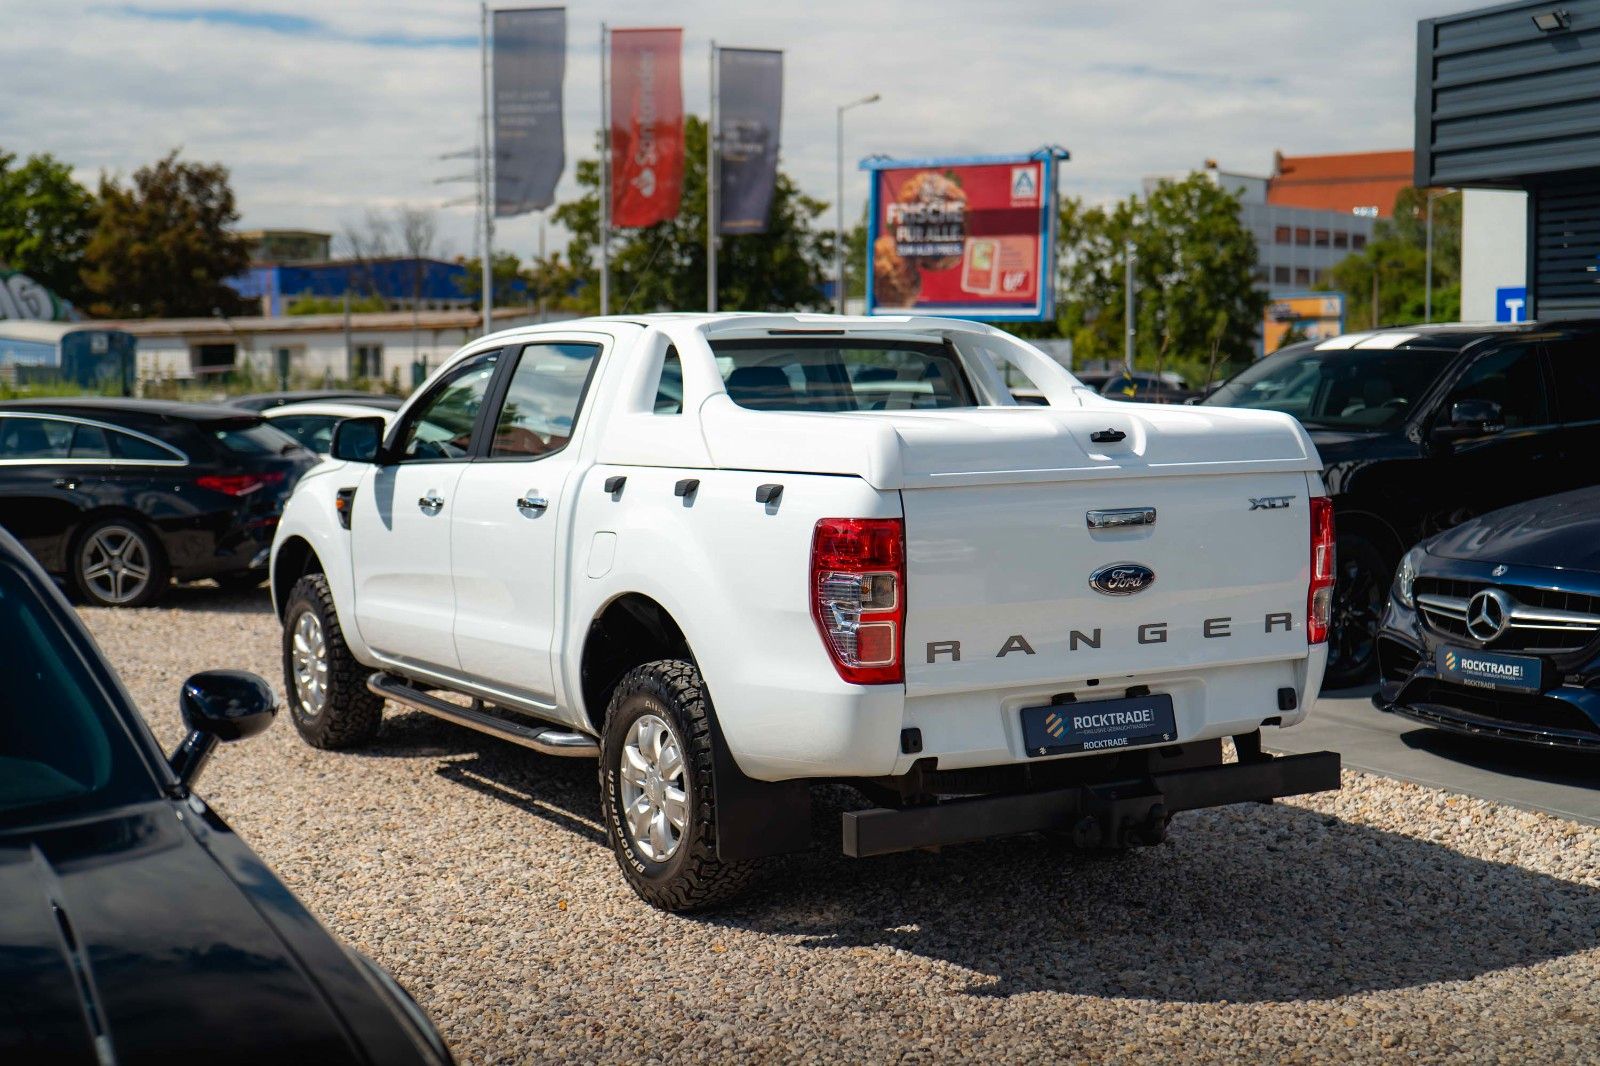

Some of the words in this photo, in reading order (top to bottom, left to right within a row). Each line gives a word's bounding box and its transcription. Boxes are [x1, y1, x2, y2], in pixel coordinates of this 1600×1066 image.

[1248, 495, 1296, 511] XLT
[1108, 569, 1143, 589] Ford
[926, 612, 1292, 663] RANGER
[1461, 658, 1520, 676] ROCKTRADE
[1463, 679, 1496, 690] ROCKTRADE
[1073, 709, 1151, 729] ROCKTRADE
[1083, 737, 1128, 750] ROCKTRADE
